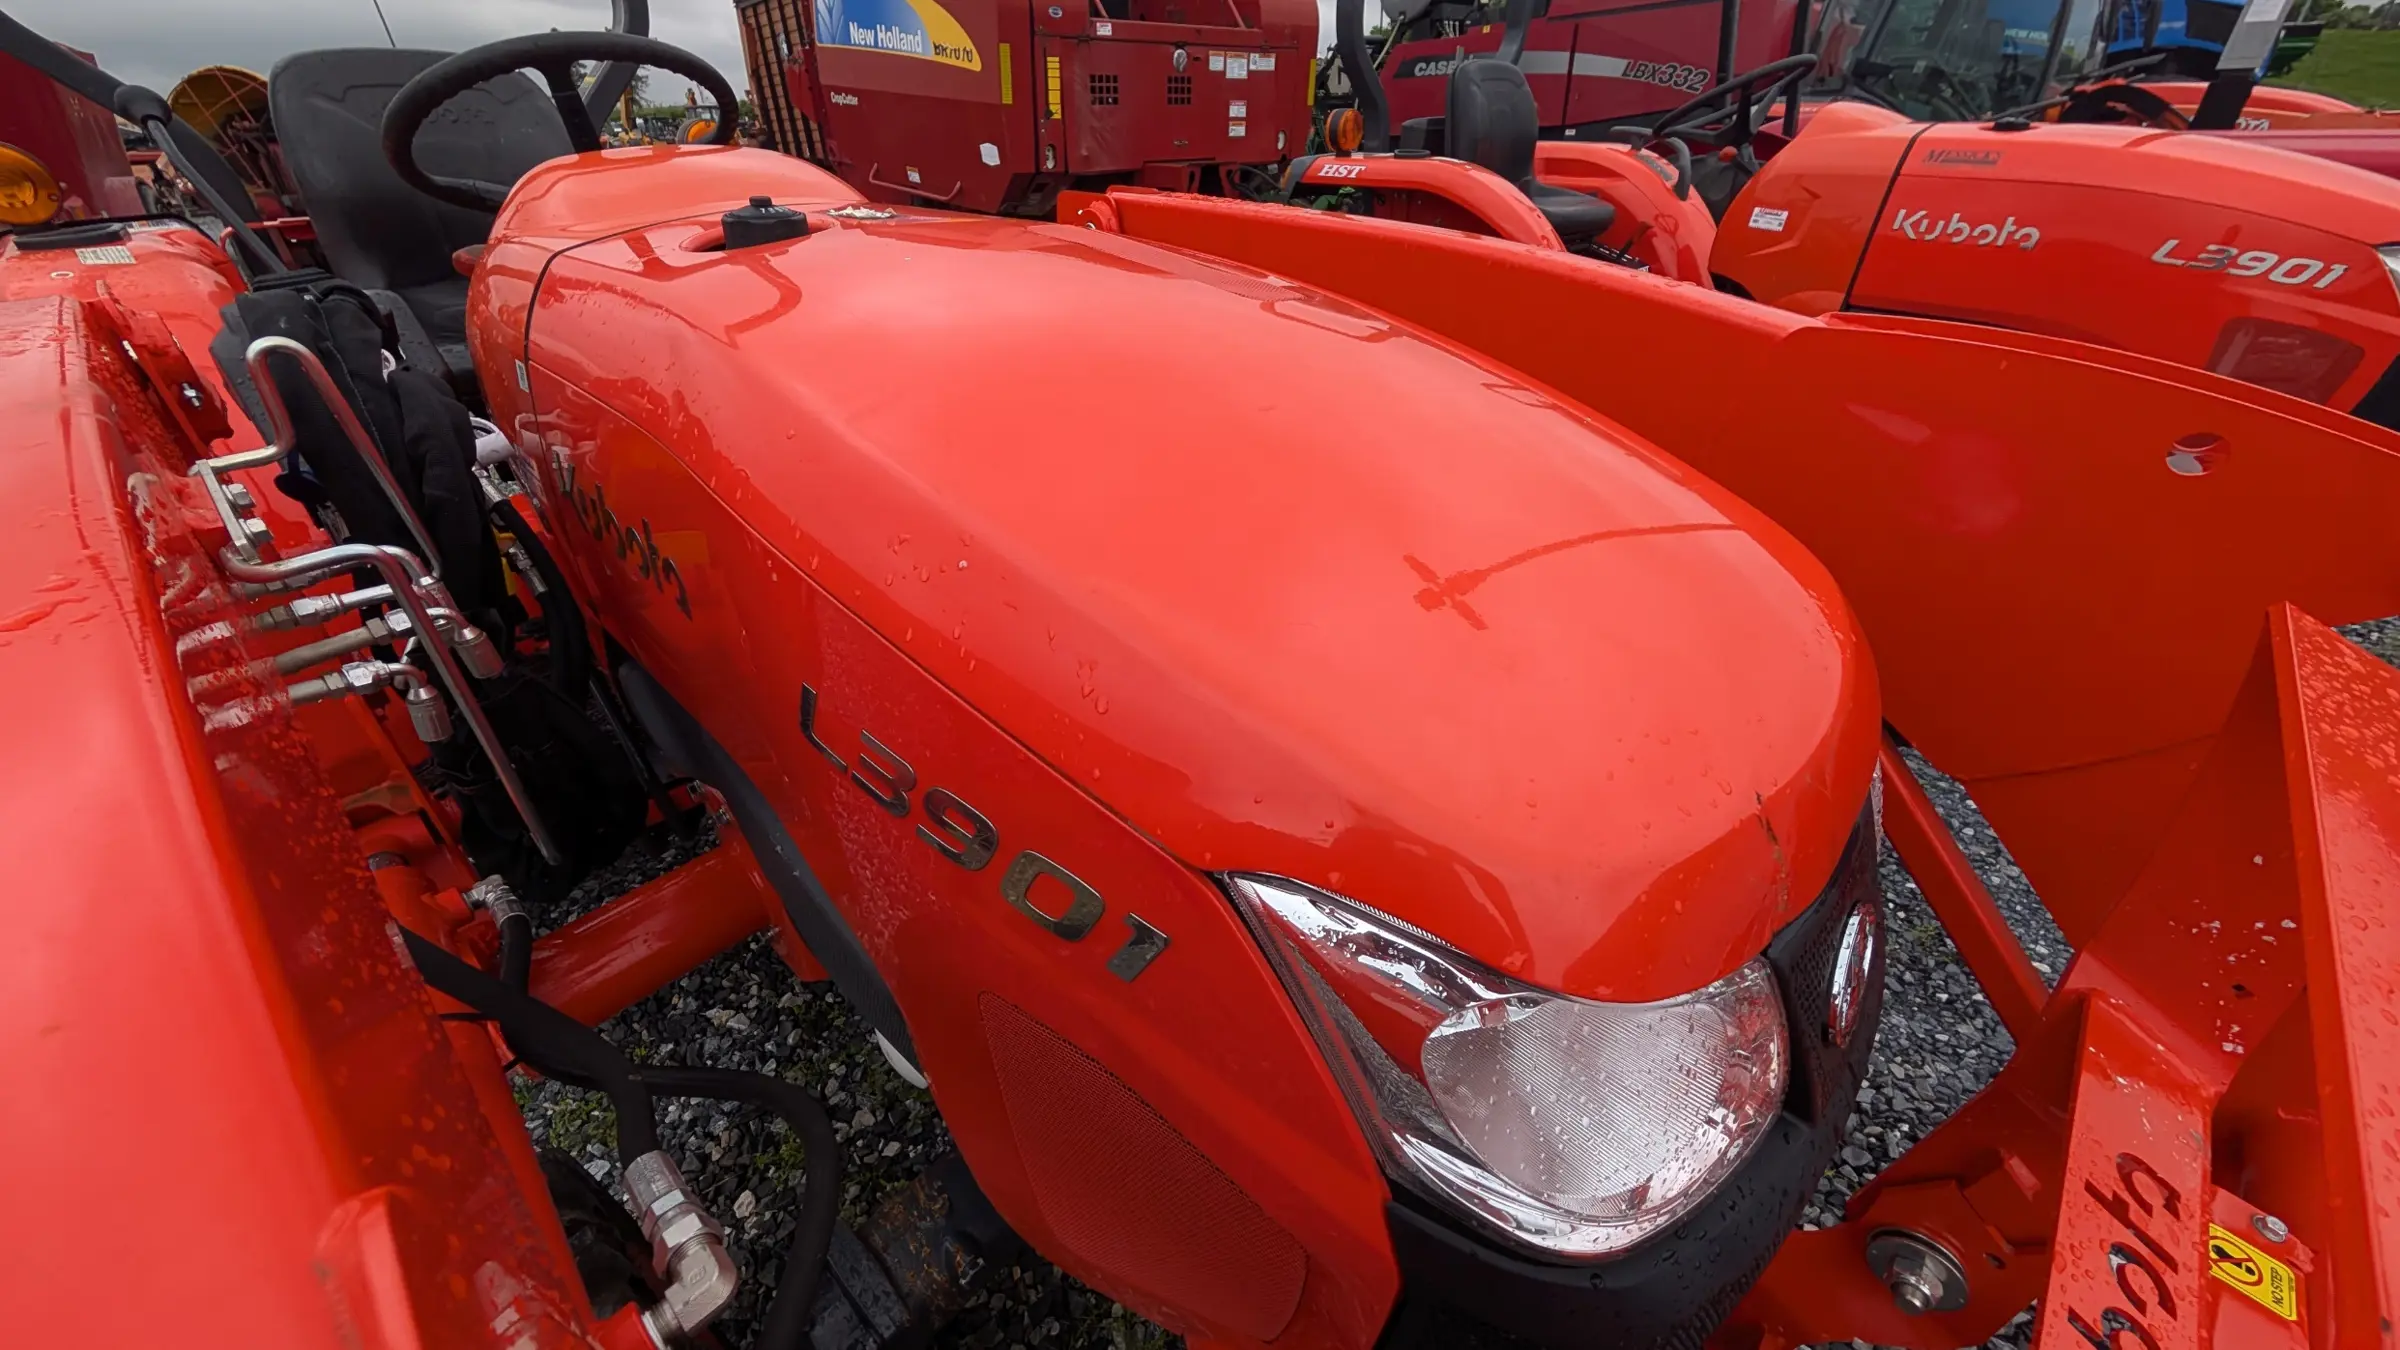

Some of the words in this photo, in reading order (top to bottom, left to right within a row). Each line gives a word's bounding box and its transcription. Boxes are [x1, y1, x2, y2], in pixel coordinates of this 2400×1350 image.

[849, 22, 875, 46] New
[876, 24, 922, 53] Holland
[1621, 60, 1711, 94] LBX332
[1317, 164, 1367, 179] HST
[1892, 208, 2041, 250] Kubota
[2150, 238, 2349, 289] L3901
[553, 451, 693, 622] Kubota
[799, 681, 1172, 984] L3901
[2269, 1265, 2283, 1293] STEP
[2270, 1290, 2285, 1309] NO
